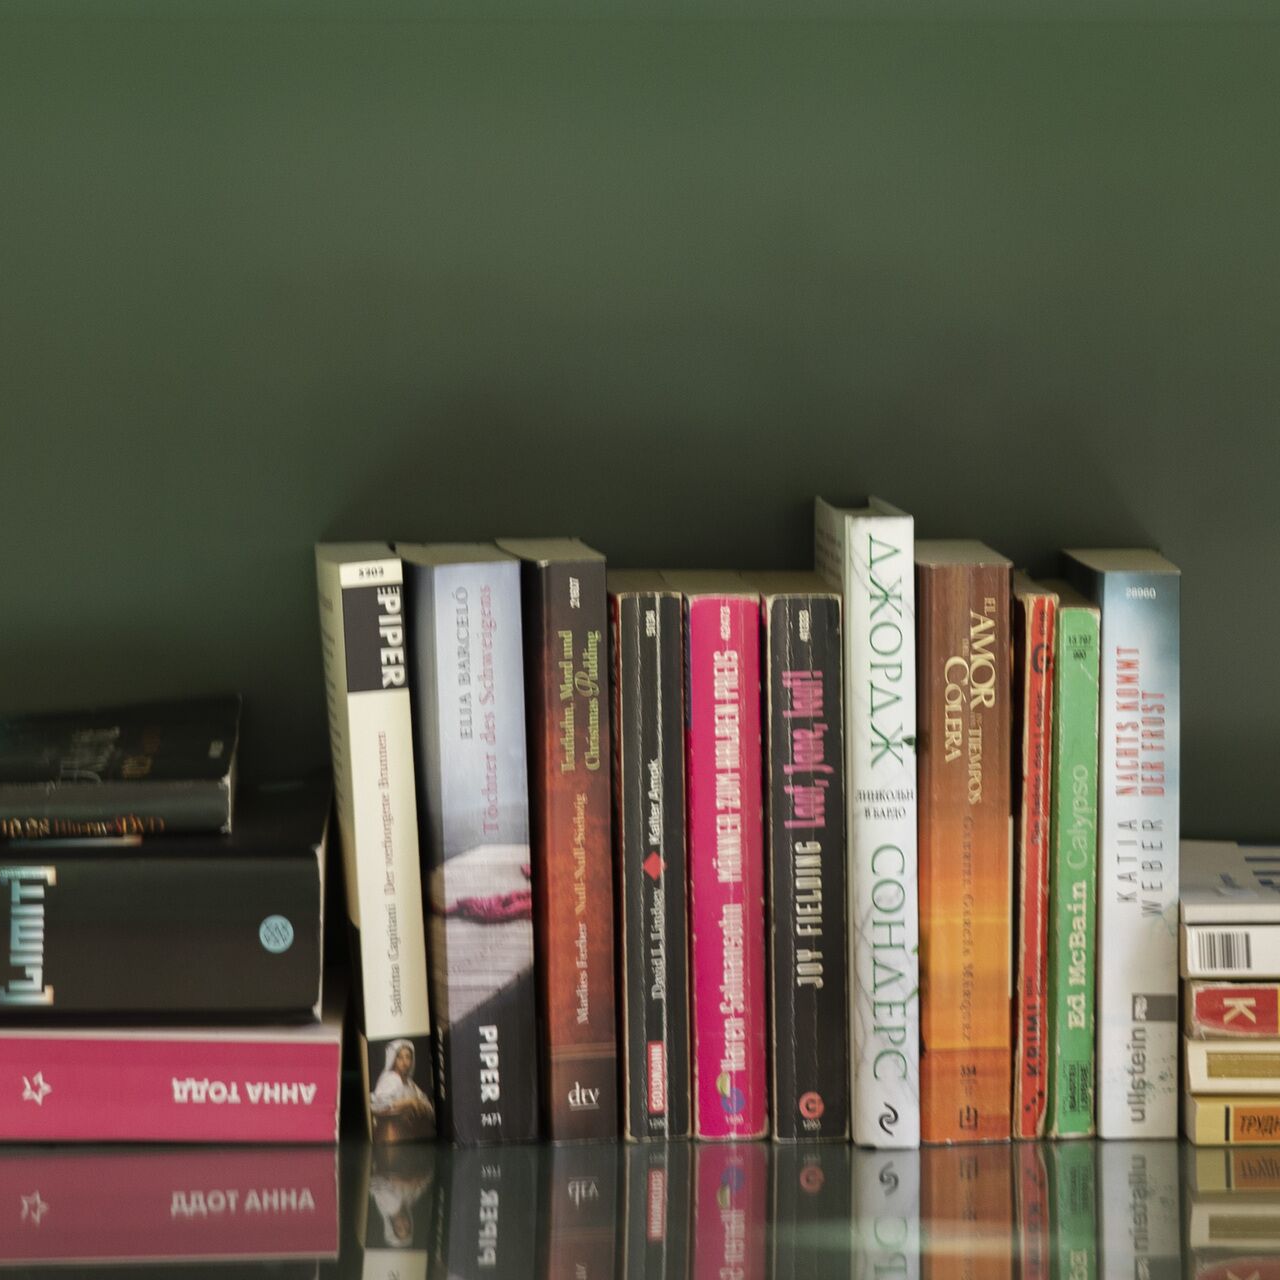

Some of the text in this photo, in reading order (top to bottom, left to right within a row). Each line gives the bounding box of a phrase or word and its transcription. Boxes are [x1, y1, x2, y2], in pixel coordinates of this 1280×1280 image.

[376, 590, 407, 689] PIPER
[451, 586, 474, 741] ELIA BARCELÓ
[712, 650, 740, 701] PREIS
[867, 532, 904, 769] ДЖОРДЖ
[969, 607, 997, 713] AMOR
[480, 712, 497, 746] des
[713, 703, 741, 770] HALBEN
[943, 654, 970, 765] CÓLERA
[1115, 644, 1140, 797] NACHTS KOMMT
[1140, 689, 1166, 798] DER FROST
[714, 772, 742, 811] ZUM
[854, 788, 915, 804] ЛИНКОЛЬН
[967, 725, 983, 806] TIEMPOS
[1066, 764, 1093, 1032] Ed McBain Calypso
[1116, 819, 1138, 904] KATIA
[1141, 818, 1164, 918] WEBER
[794, 840, 825, 990] JOY FIELDING
[870, 842, 909, 1082] СОНДЕРС
[1222, 997, 1257, 1025] K
[171, 1076, 318, 1105] АННА ТОДД
[478, 1023, 501, 1103] PIPER
[1126, 1025, 1147, 1125] ullstein
